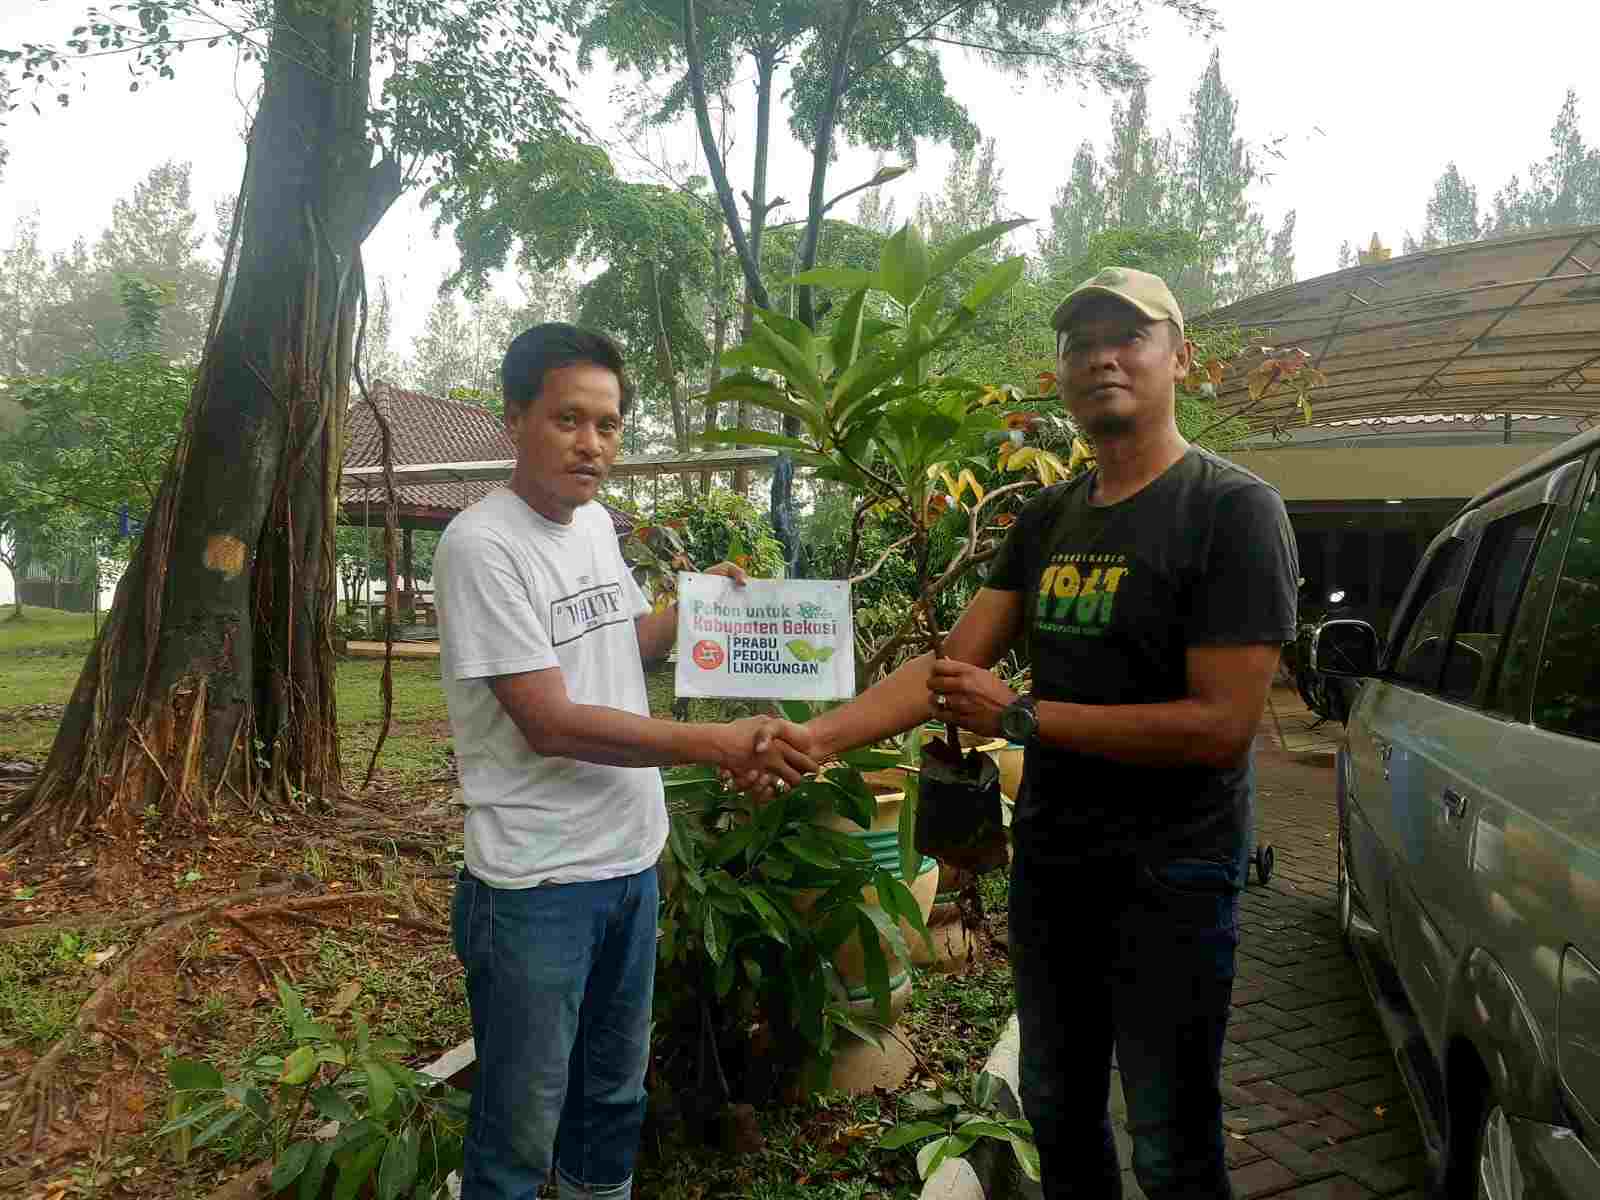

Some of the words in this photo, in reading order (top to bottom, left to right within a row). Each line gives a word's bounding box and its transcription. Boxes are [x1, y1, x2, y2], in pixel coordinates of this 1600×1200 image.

[746, 602, 791, 619] untuk
[783, 619, 837, 635] Bekasi
[733, 637, 777, 649] PRABU
[733, 650, 780, 662] PEDULI
[733, 663, 819, 675] LINGKUNGAN
